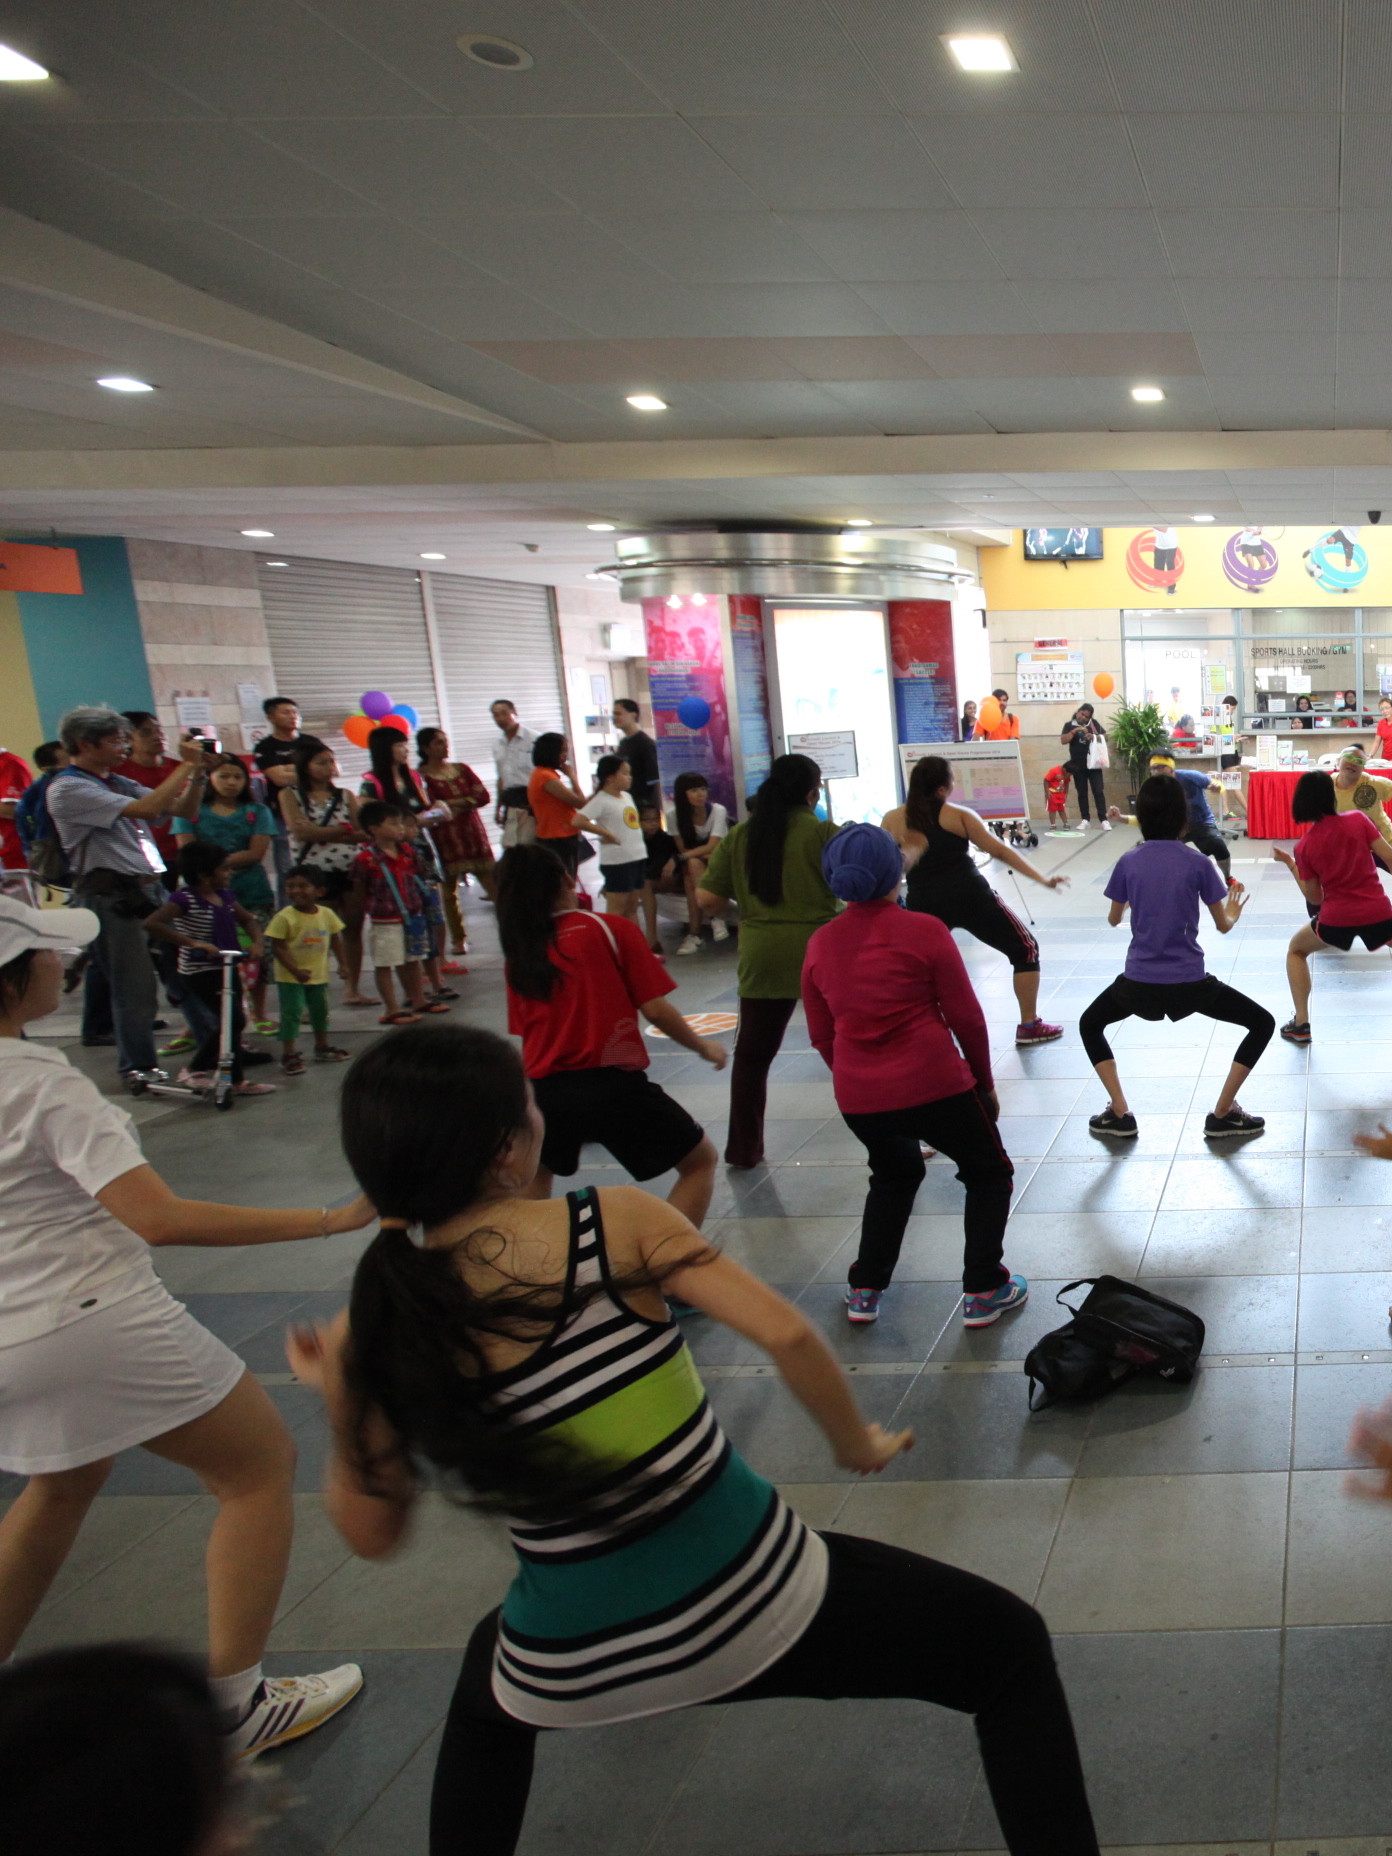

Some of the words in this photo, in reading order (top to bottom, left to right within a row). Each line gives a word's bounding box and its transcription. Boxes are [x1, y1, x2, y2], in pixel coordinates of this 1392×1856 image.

[1166, 650, 1196, 659] POOL
[1251, 647, 1277, 656] SPORTS
[1278, 647, 1295, 656] HALL
[1297, 646, 1327, 656] BOOKING
[1332, 646, 1347, 655] GYM
